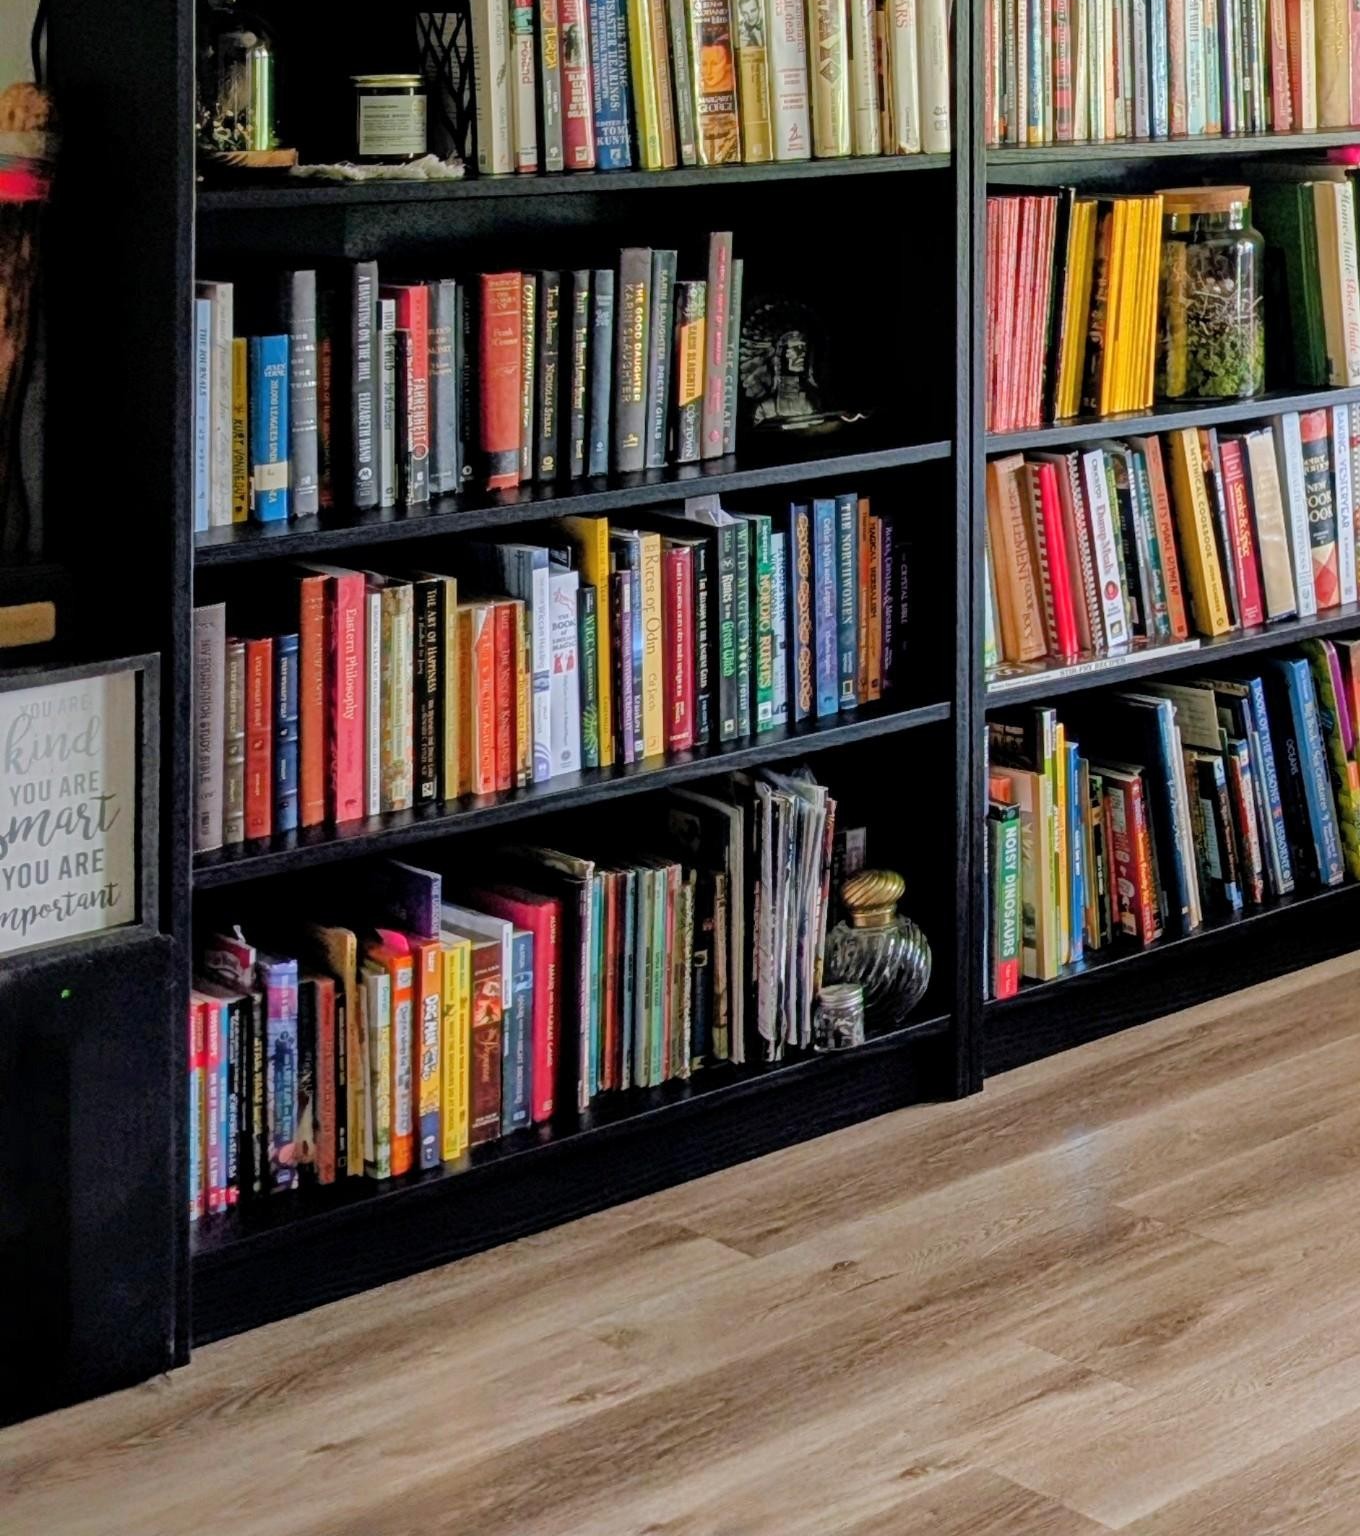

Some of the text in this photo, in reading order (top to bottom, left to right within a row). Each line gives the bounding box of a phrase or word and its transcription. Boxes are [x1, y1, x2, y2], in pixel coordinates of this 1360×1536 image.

[521, 40, 534, 85] Poland
[617, 15, 628, 87] THE TITANIC
[784, 13, 796, 43] dead
[358, 283, 370, 382] HAUNTING ON THE HILL
[384, 312, 394, 371] INTO WILD
[622, 283, 634, 403] KARIN SLAUGHTER
[633, 282, 643, 401] THE GOOD DAUGHTER
[655, 269, 668, 439] KARIN SLAUGHTER PRETTY GIRLS
[686, 326, 697, 398] KARIN SLAUGHTER
[199, 347, 208, 397] JOURNALS
[723, 375, 733, 428] CELLAR
[269, 406, 279, 441] LEAGUES
[359, 392, 371, 463] ELIZABETH HAND
[413, 378, 426, 442] FAHRENHEIT
[233, 419, 244, 501] KURT VONNEGUT
[1337, 412, 1349, 528] BAKING YESTERYEAR
[1007, 487, 1031, 582] SETTLEMENT
[1161, 522, 1172, 554] MAKE
[1190, 447, 1212, 559] MYTHICAL COOKBOOK
[1234, 483, 1251, 557] Smoke & Spice
[738, 528, 747, 633] WILD MAGIC
[822, 544, 833, 617] Myth Legend
[841, 503, 853, 625] THE NORTHWOMEN
[343, 608, 358, 720] Eastern Philosophy
[426, 590, 437, 693] THE ART OF HAPPINESS
[722, 621, 736, 677] Green Witch
[758, 574, 772, 689] NORDIC RUNES
[19, 693, 91, 720] YOU ARE
[199, 639, 212, 783] NIV FOUNDATION STUDY BIBLE
[4, 713, 99, 775] kind
[1253, 685, 1280, 803] BOOK OF THE SEASONS
[9, 770, 99, 807] YOU ARE
[1315, 767, 1328, 811] Creatures
[2, 848, 104, 892] YOU ARE
[1274, 820, 1290, 870] USBORNE
[1001, 827, 1018, 957] NOISY DINOSAURS
[424, 995, 439, 1046] DOG MAN
